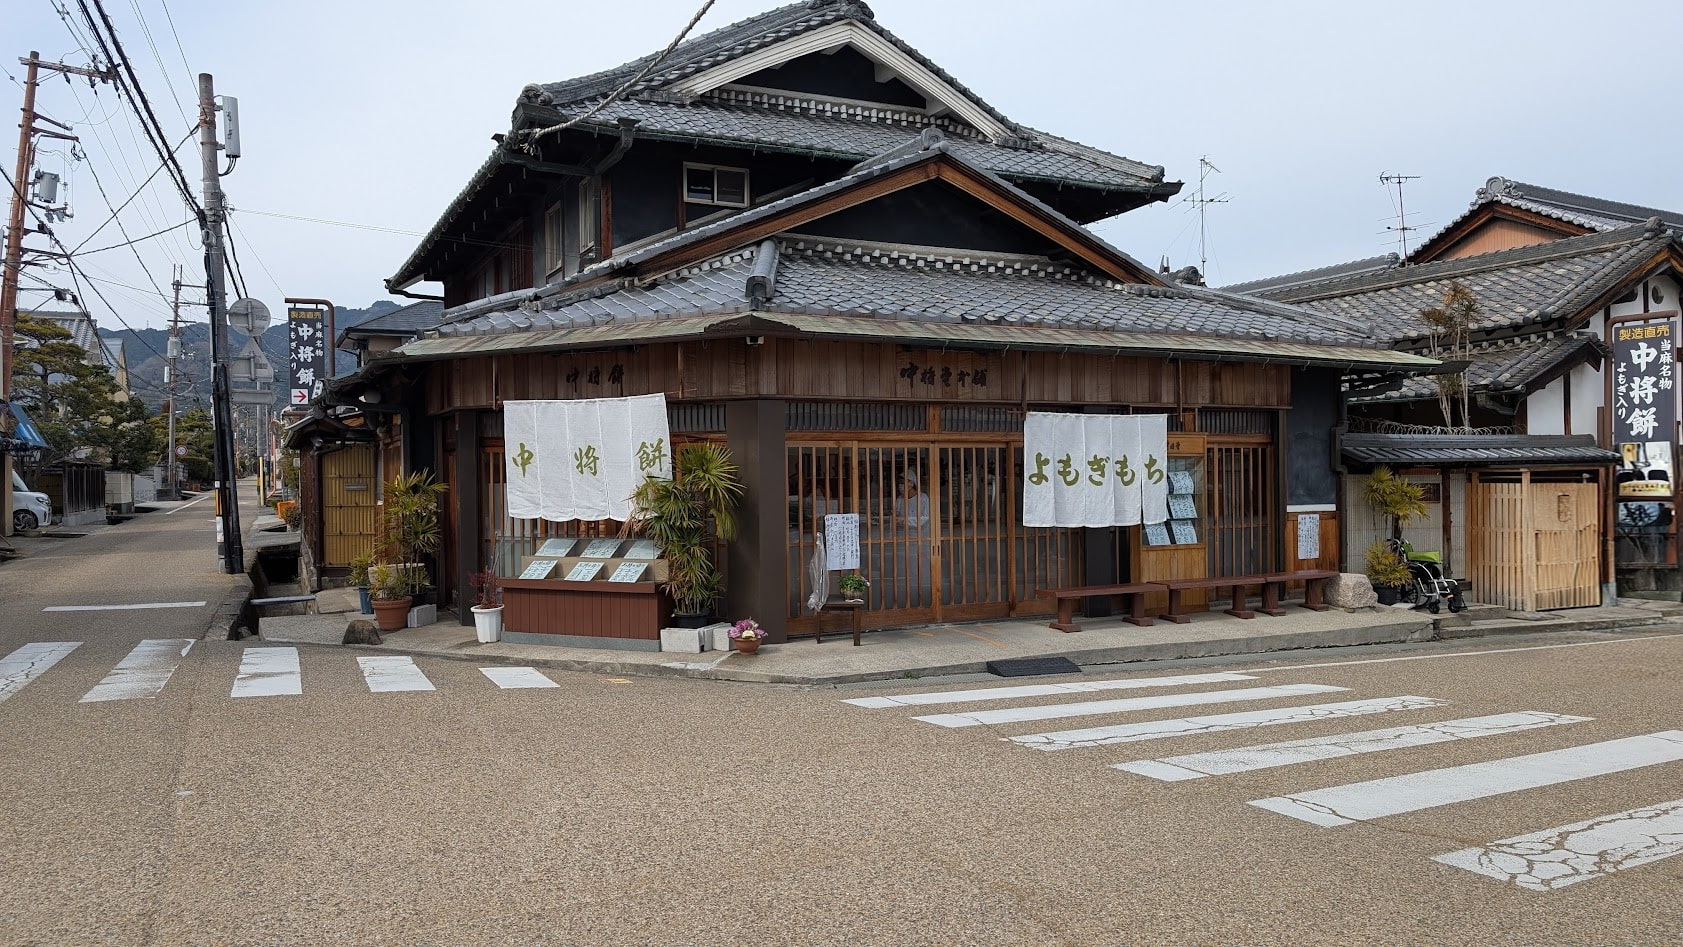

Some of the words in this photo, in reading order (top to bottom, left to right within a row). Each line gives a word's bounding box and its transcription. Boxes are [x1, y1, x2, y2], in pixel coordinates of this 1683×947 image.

[290, 311, 322, 319] 製造直売
[1618, 324, 1670, 341] 製造直売
[290, 321, 298, 370] よもぎ入り
[296, 323, 315, 386] 中将餅
[315, 321, 323, 357] 当麻名物
[1658, 339, 1673, 390] 当麻名物
[1616, 362, 1629, 419] よもぎ入り
[1625, 342, 1659, 439] 中将餅
[512, 438, 667, 478] 中将餅
[1028, 452, 1164, 487] よもぎもち
